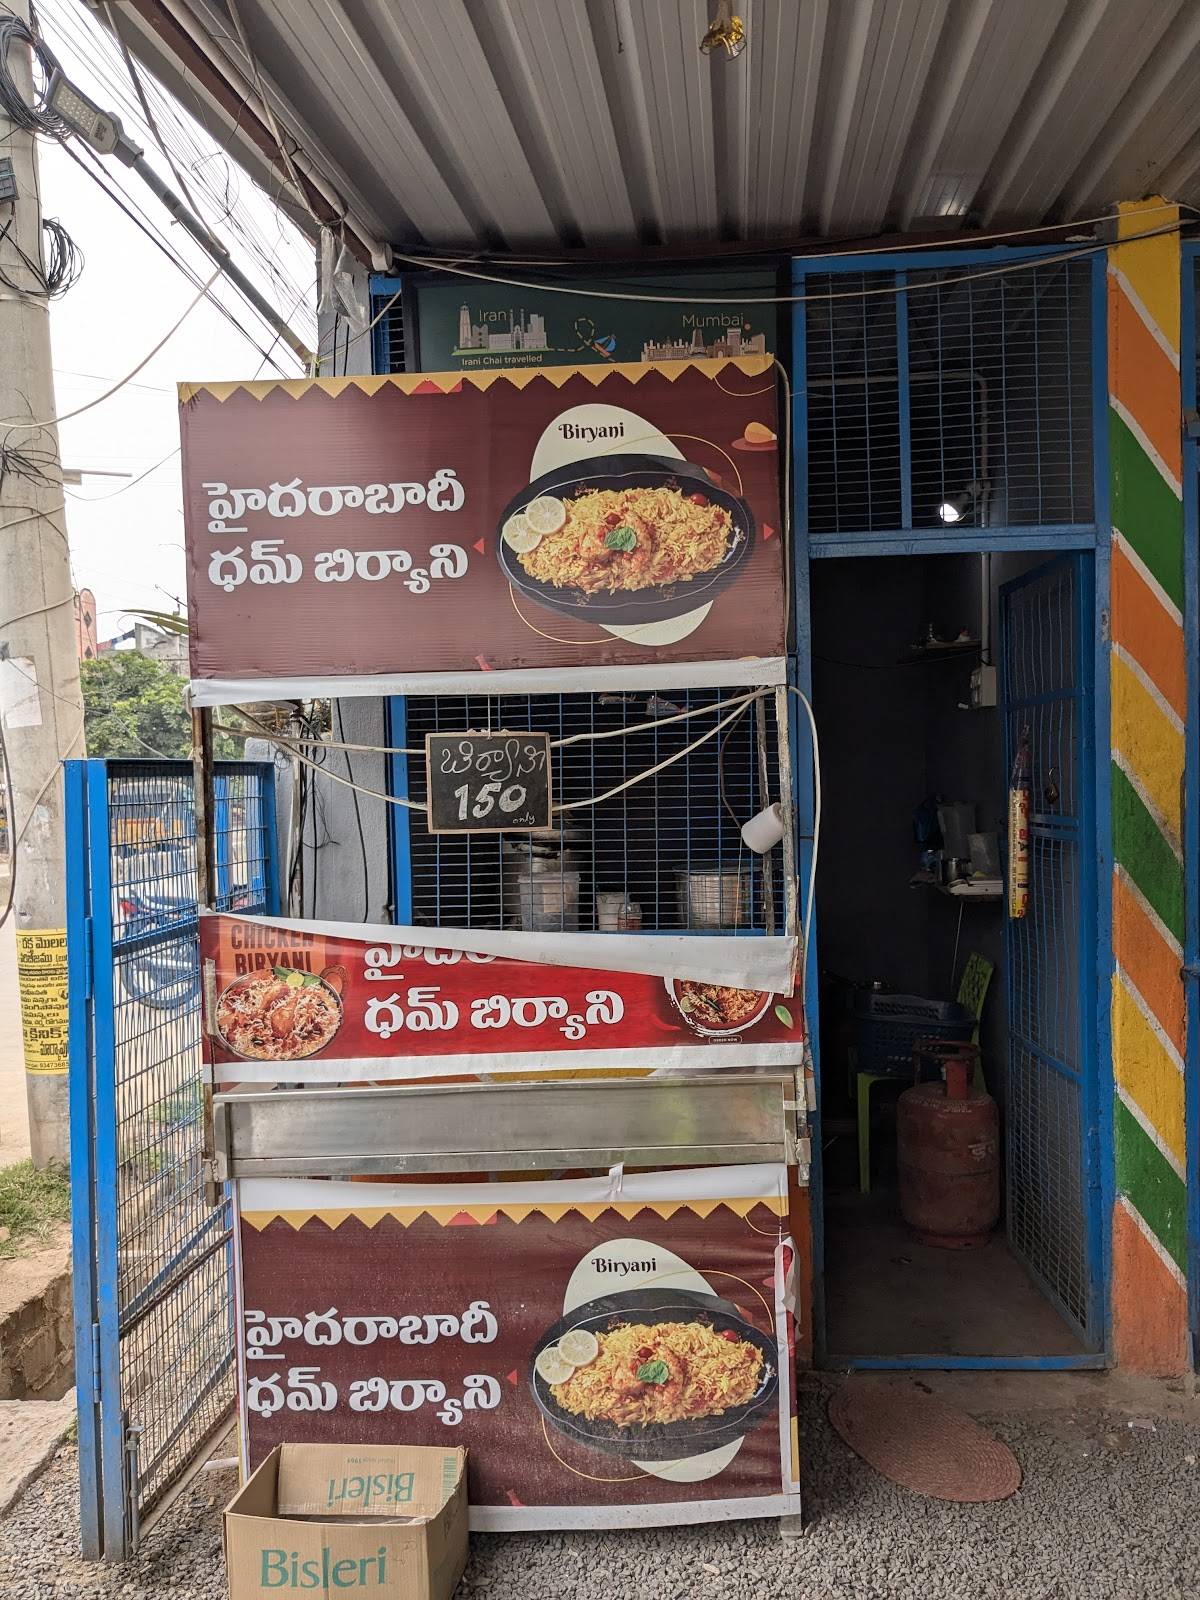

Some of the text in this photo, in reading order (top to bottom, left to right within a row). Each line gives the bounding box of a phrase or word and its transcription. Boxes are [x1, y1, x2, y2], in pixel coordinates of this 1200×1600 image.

[682, 312, 744, 328] Mumbai
[462, 358, 481, 366] Irani
[504, 353, 543, 364] travelled
[558, 422, 624, 443] Biryani
[202, 469, 465, 533] హైదరాబాదీ
[208, 539, 468, 594] ధమ్ బిర్యాని
[454, 782, 526, 821] 150
[512, 811, 536, 825] only
[234, 950, 312, 977] BIRYANI
[364, 986, 625, 1040] ధమ్ బిర్యాని
[591, 1256, 657, 1276] Biryani
[244, 1300, 498, 1360] హైదరాబాదీ
[247, 1366, 502, 1426] ధమ్ బిర్యాని
[327, 1472, 415, 1508] Bisleri
[260, 1545, 388, 1590] Bisleri
